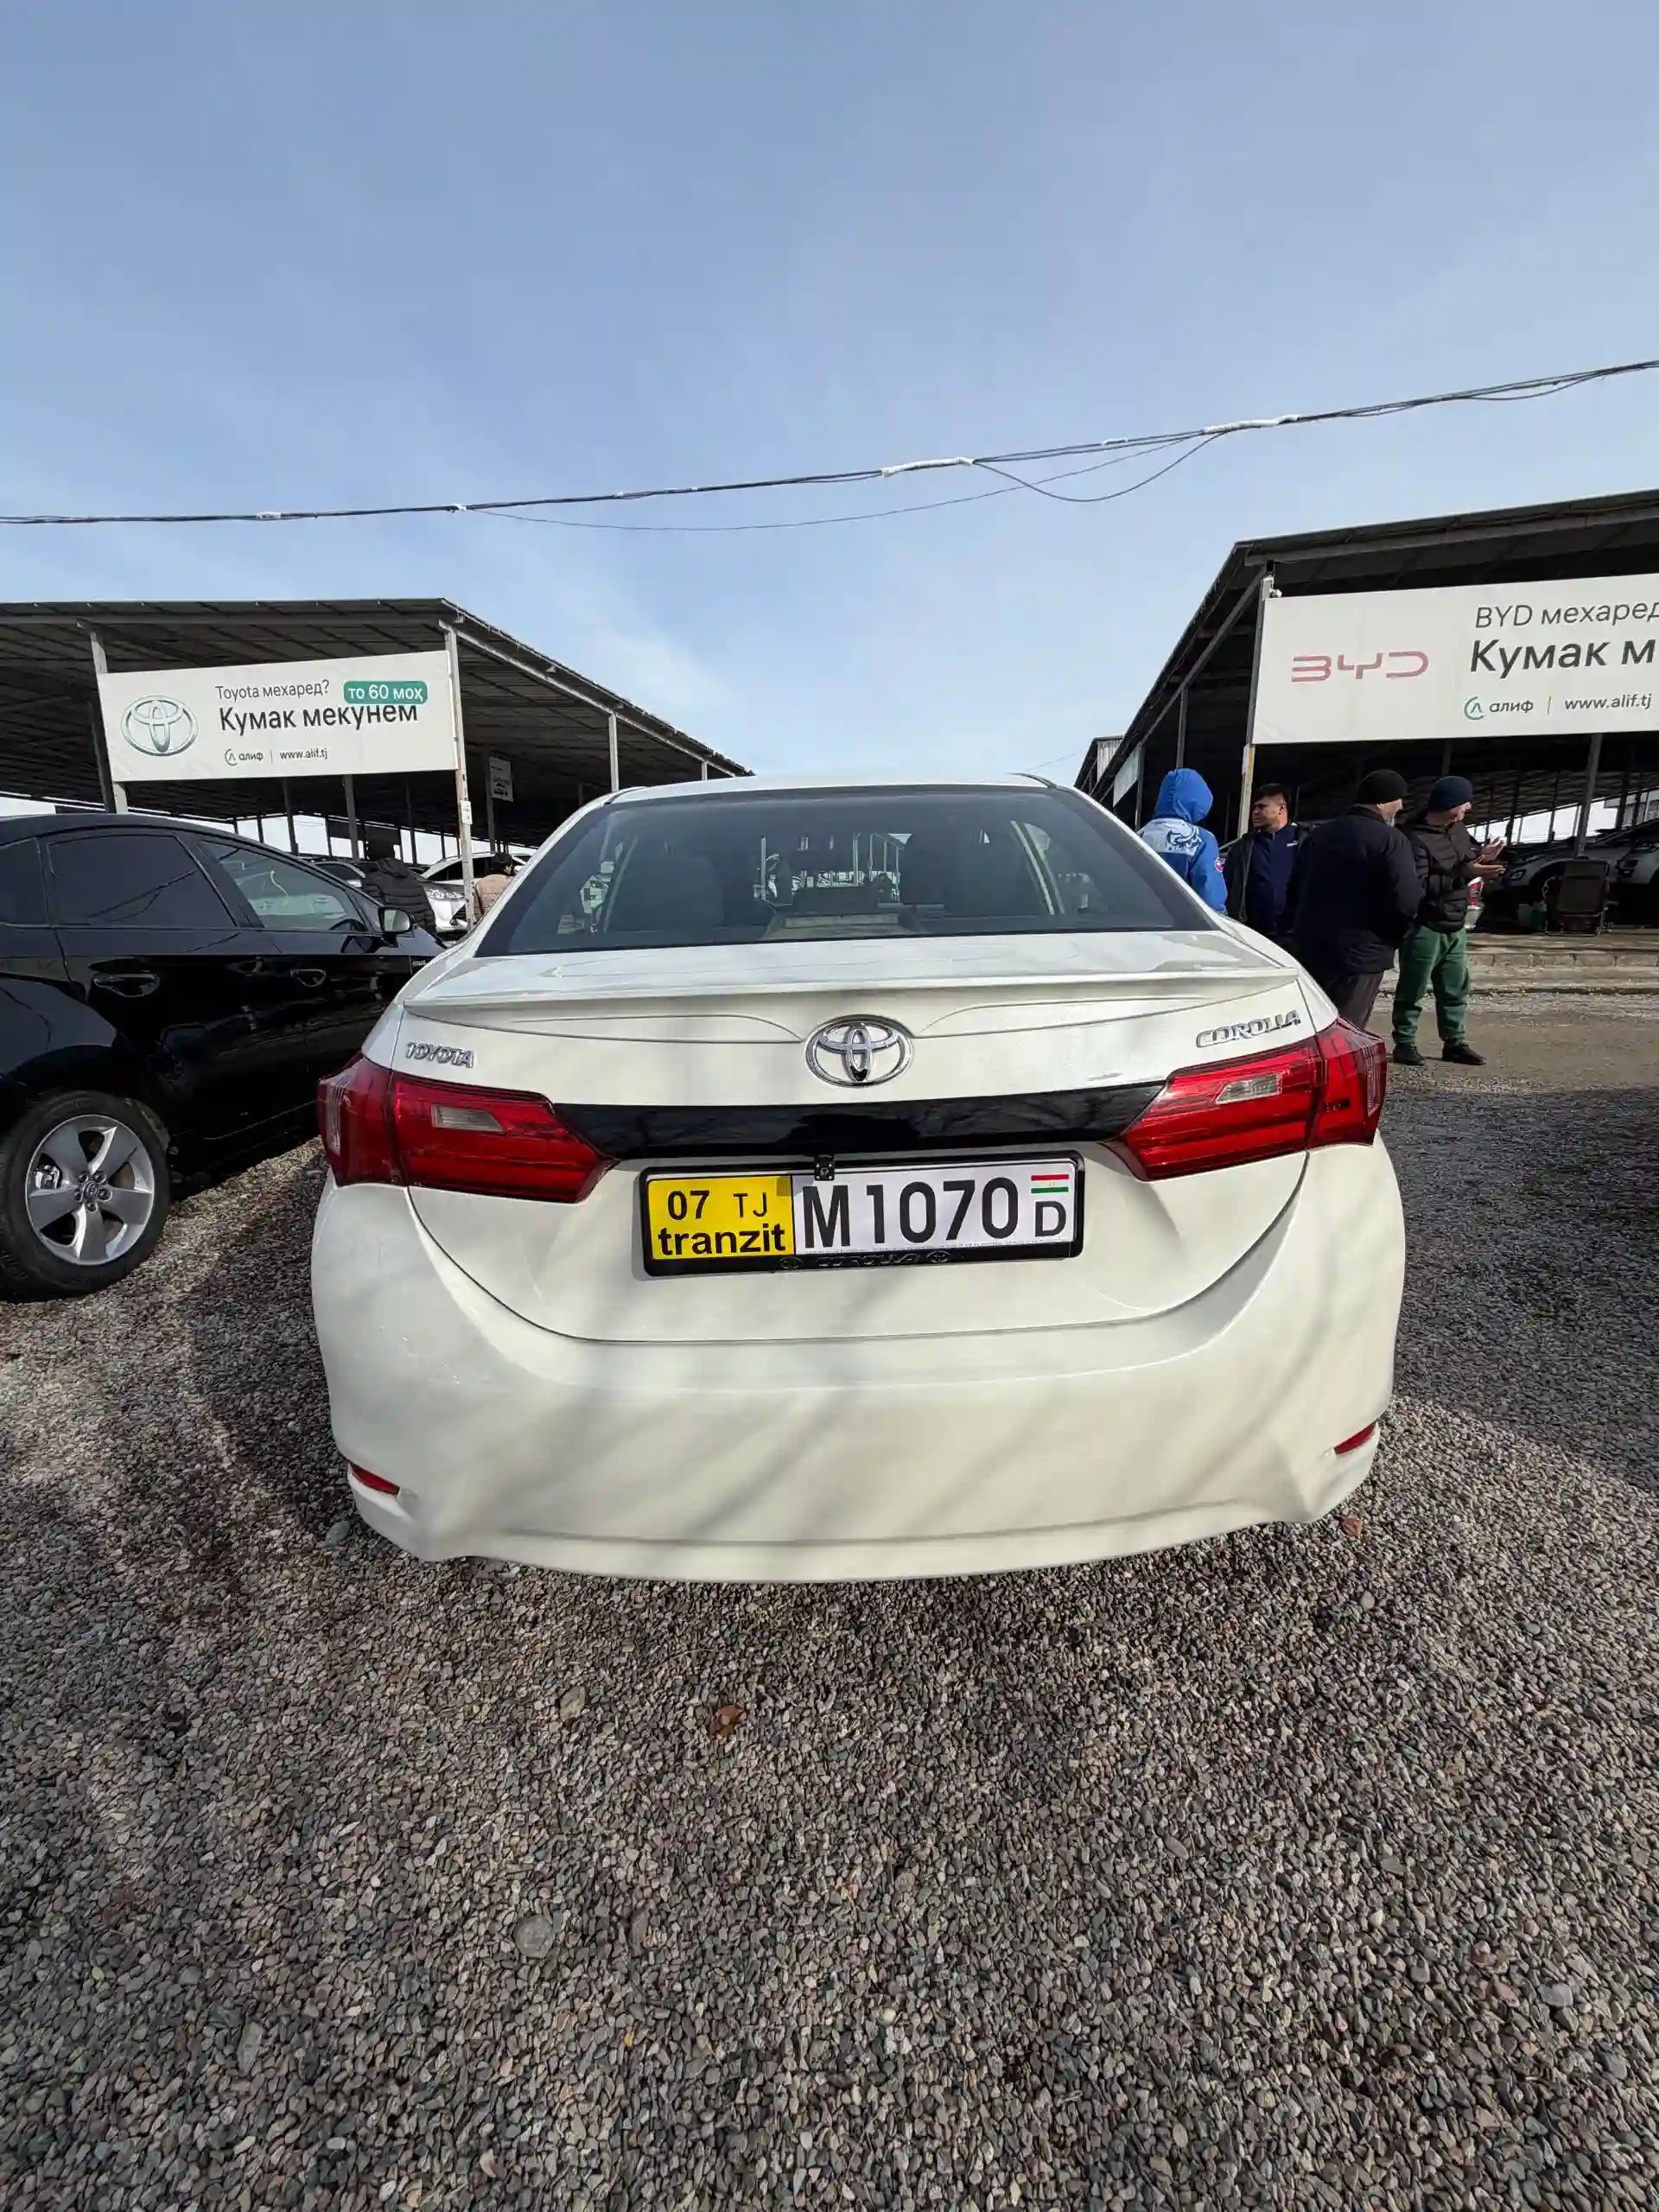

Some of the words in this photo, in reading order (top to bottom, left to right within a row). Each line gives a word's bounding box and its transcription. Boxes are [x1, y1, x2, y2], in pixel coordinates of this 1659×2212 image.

[1476, 605, 1533, 628] BYD
[1292, 651, 1429, 683] BYD
[1471, 639, 1611, 679] Кумак
[214, 685, 259, 702] Toyota
[263, 679, 329, 698] мехаред?
[347, 688, 365, 700] то
[368, 683, 389, 700] 60
[1489, 700, 1534, 714] алиф
[1565, 693, 1652, 709] www.alif.tj
[219, 707, 296, 736] Кумак
[302, 705, 417, 731] мекунем
[238, 751, 264, 761] алиф
[279, 747, 328, 760] www.alif.tj
[1196, 1009, 1301, 1048] COROLLA
[406, 1041, 474, 1069] TOYOTA
[667, 1190, 710, 1220] 07
[734, 1192, 767, 1218] TJ
[1035, 1200, 1067, 1237] D
[658, 1222, 786, 1256] tranzit
